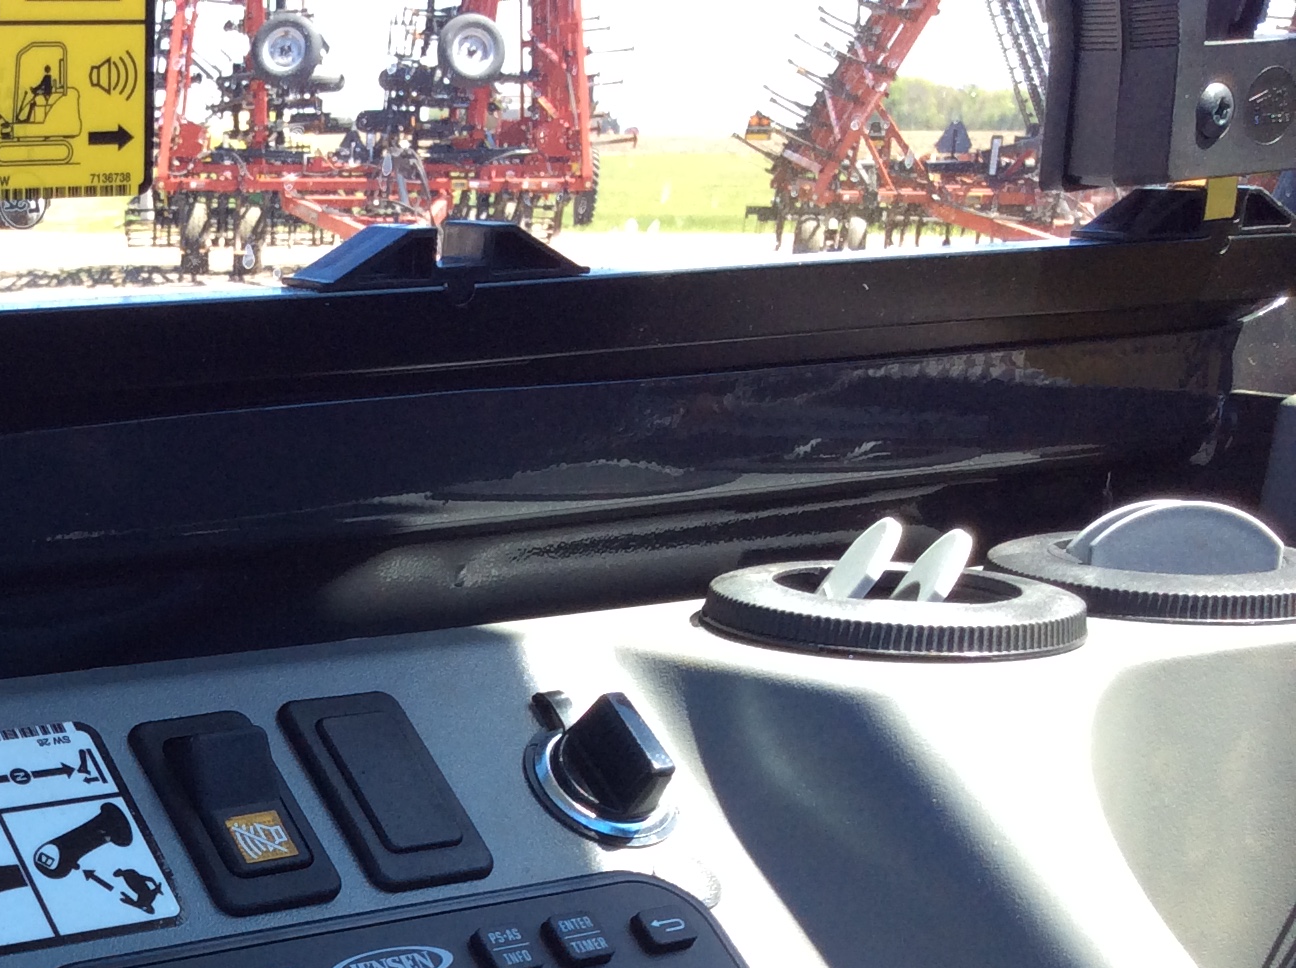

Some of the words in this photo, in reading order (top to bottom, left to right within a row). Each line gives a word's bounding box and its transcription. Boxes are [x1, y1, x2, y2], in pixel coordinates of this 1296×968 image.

[90, 172, 132, 185] 7136738
[558, 915, 594, 933] ENTER
[570, 936, 609, 954] TIMER
[502, 949, 532, 966] INFO
